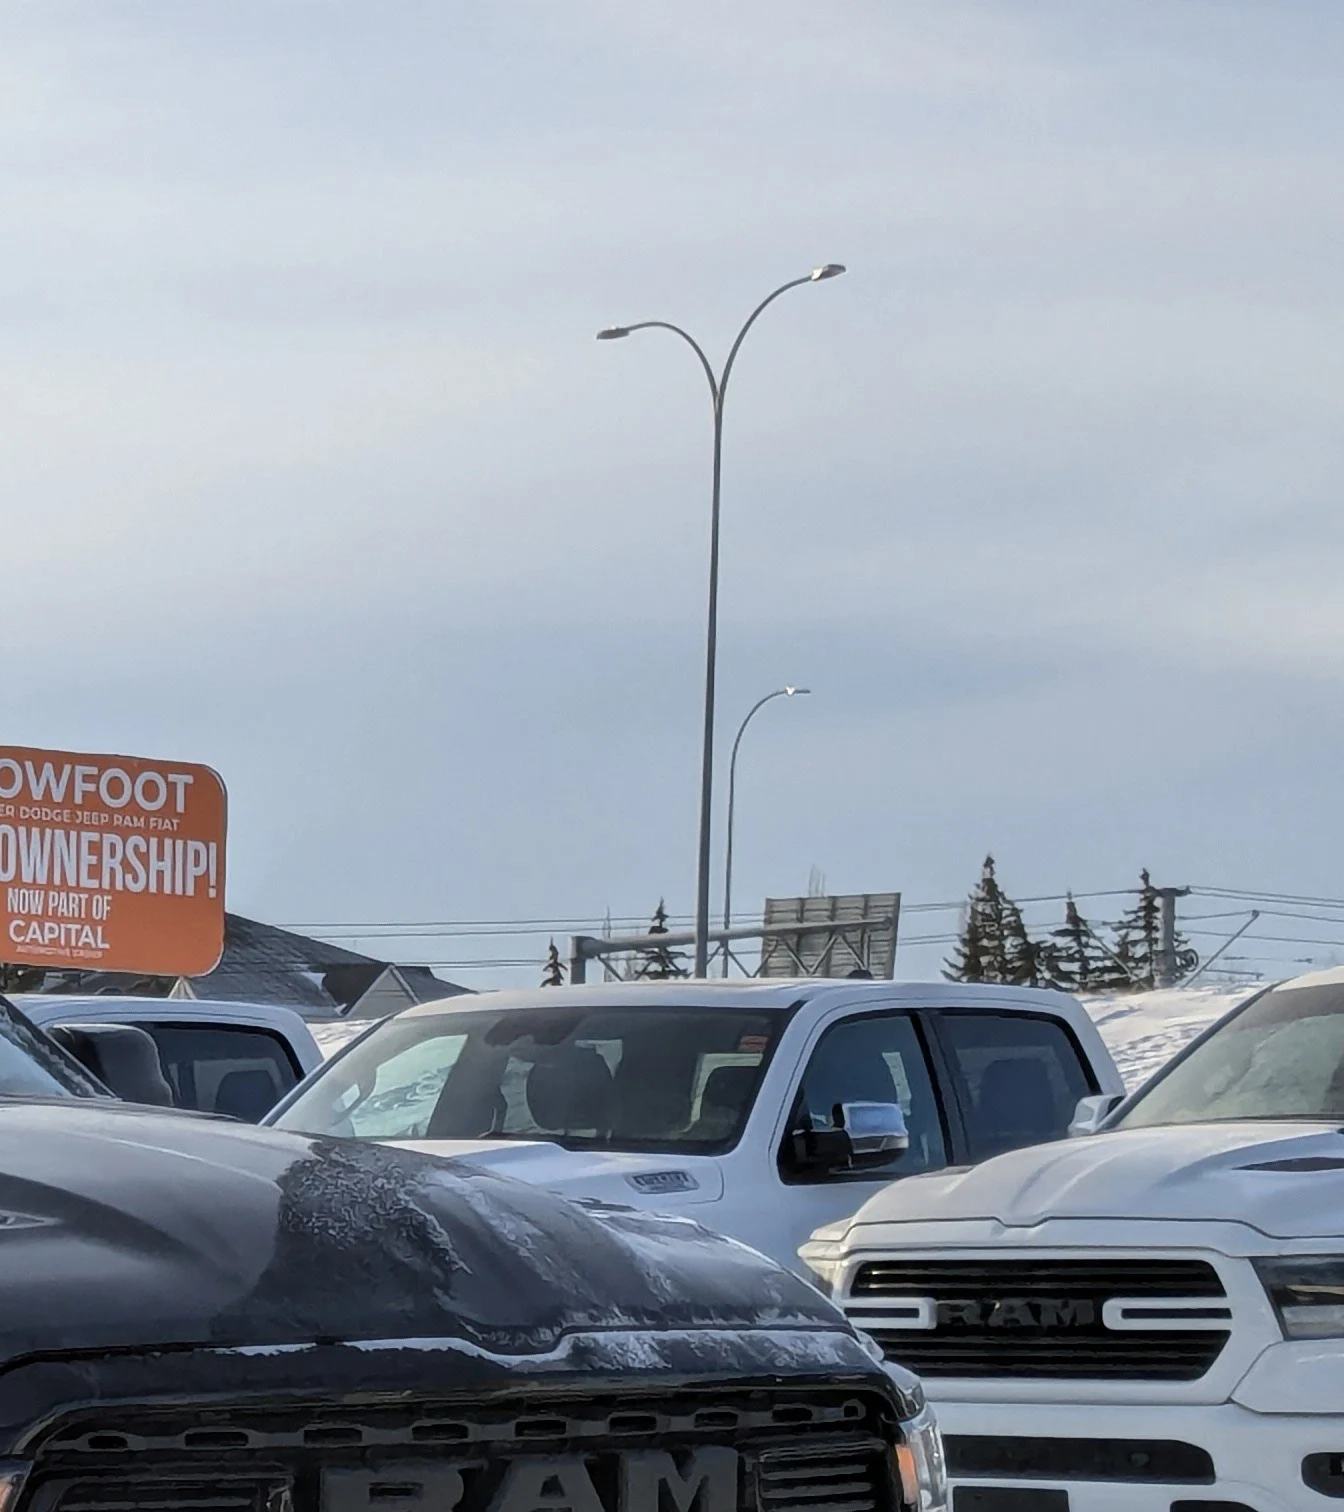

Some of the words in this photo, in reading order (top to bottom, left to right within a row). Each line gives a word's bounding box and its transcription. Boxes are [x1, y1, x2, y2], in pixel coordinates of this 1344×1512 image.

[19, 805, 72, 823] DODGE
[75, 810, 109, 826] JEEP
[113, 813, 145, 829] RAM
[149, 817, 180, 833] FIAT
[7, 887, 44, 915] NOW
[48, 890, 89, 920] PART
[92, 894, 112, 921] OF
[8, 920, 110, 950] CAPITAL
[937, 1298, 1095, 1329] RAM
